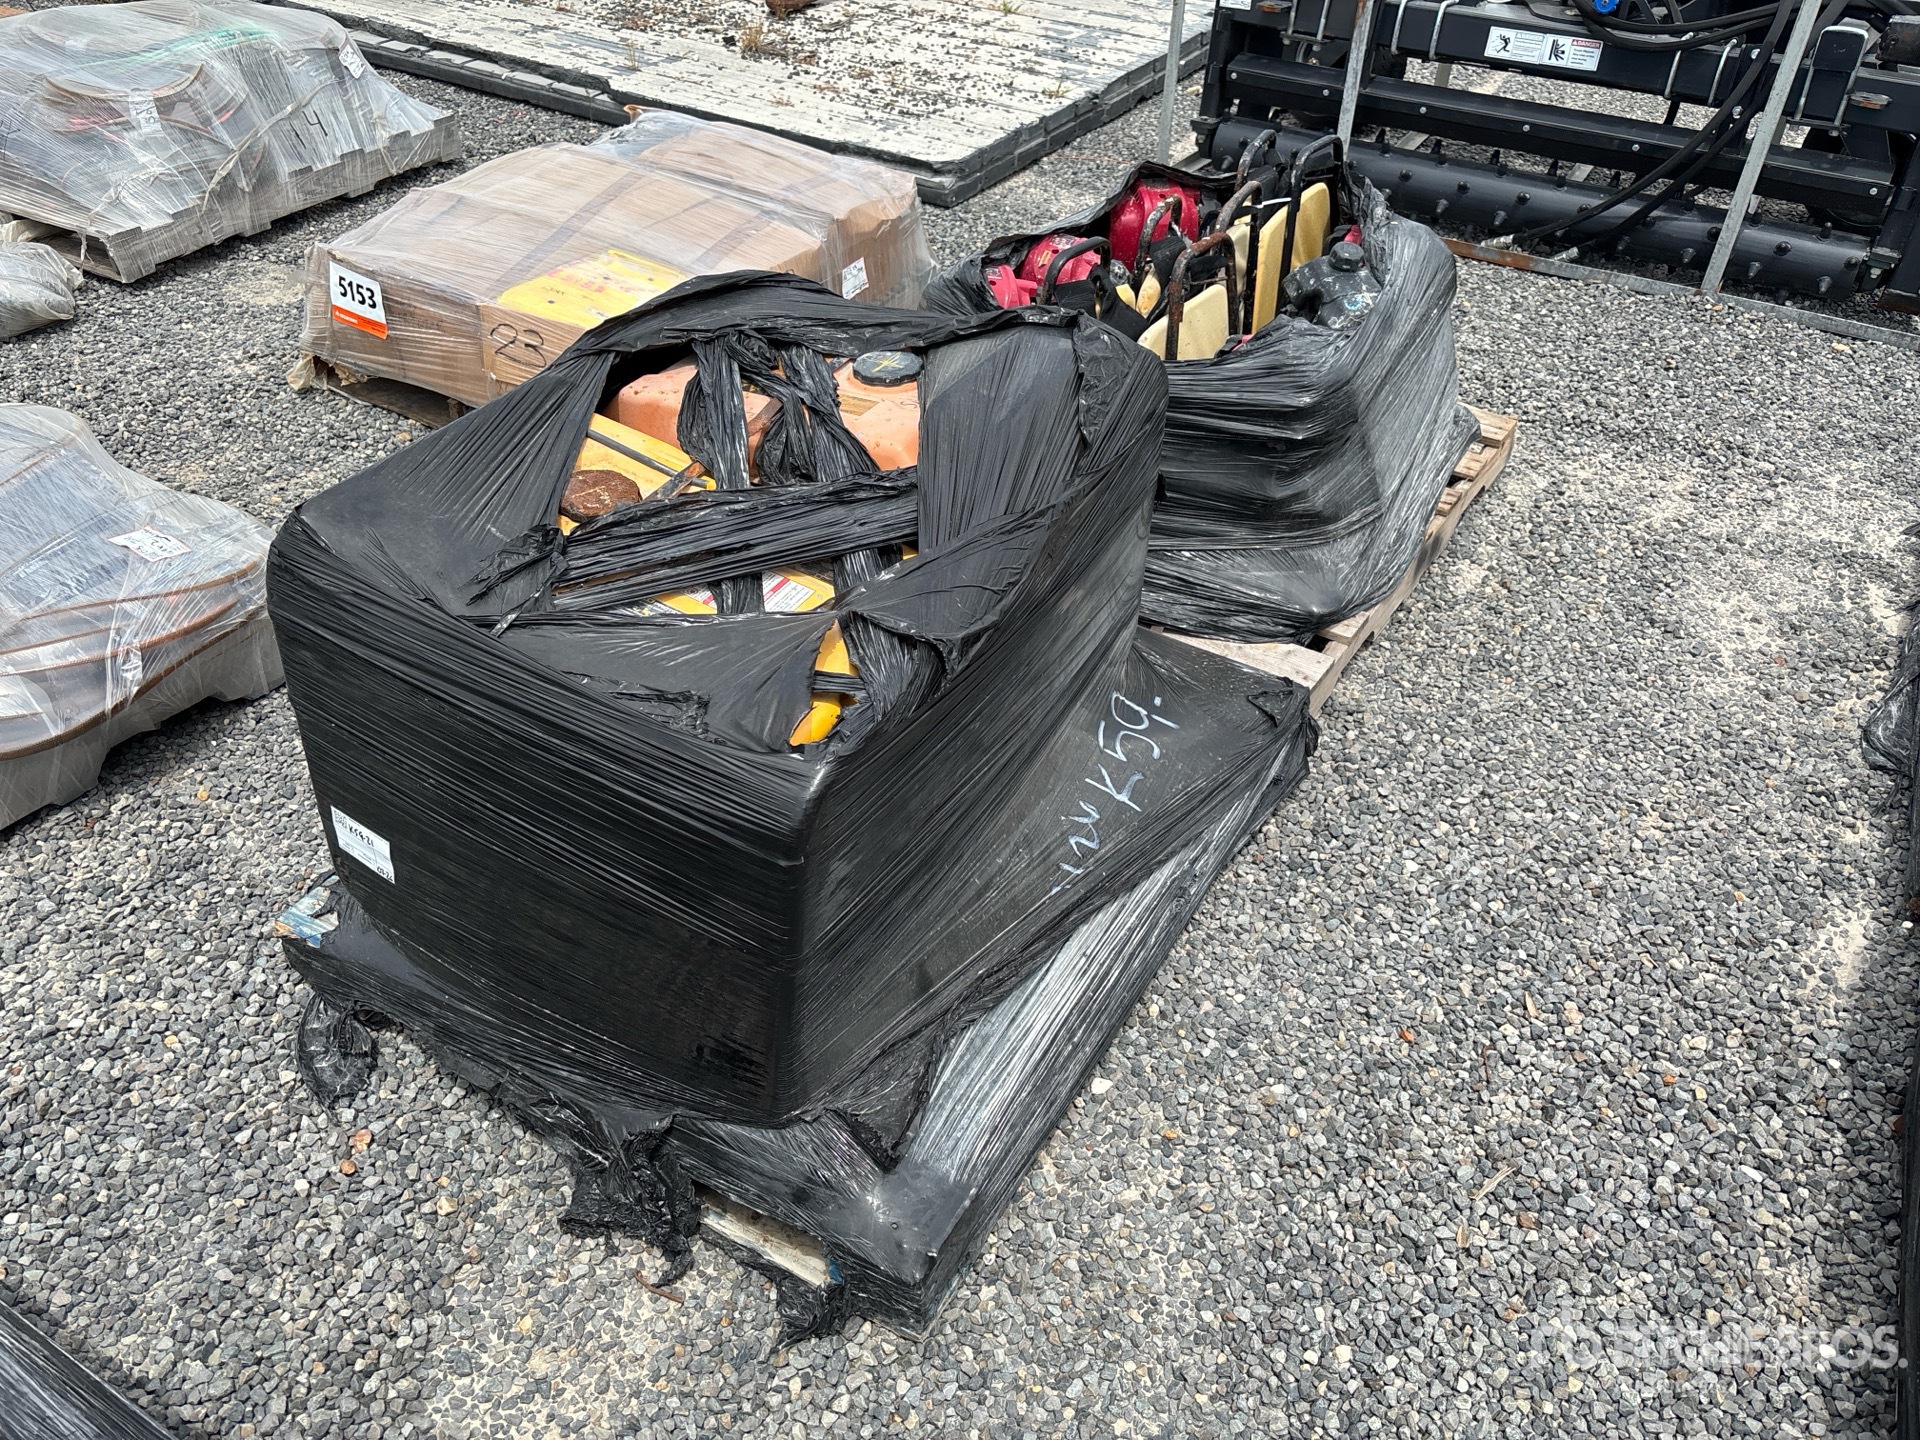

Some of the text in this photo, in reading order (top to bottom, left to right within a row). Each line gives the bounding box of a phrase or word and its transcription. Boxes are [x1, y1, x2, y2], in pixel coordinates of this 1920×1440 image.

[1577, 40, 1600, 49] DANGER
[289, 109, 329, 150] 14
[338, 274, 378, 310] 5153
[489, 322, 548, 369] 23
